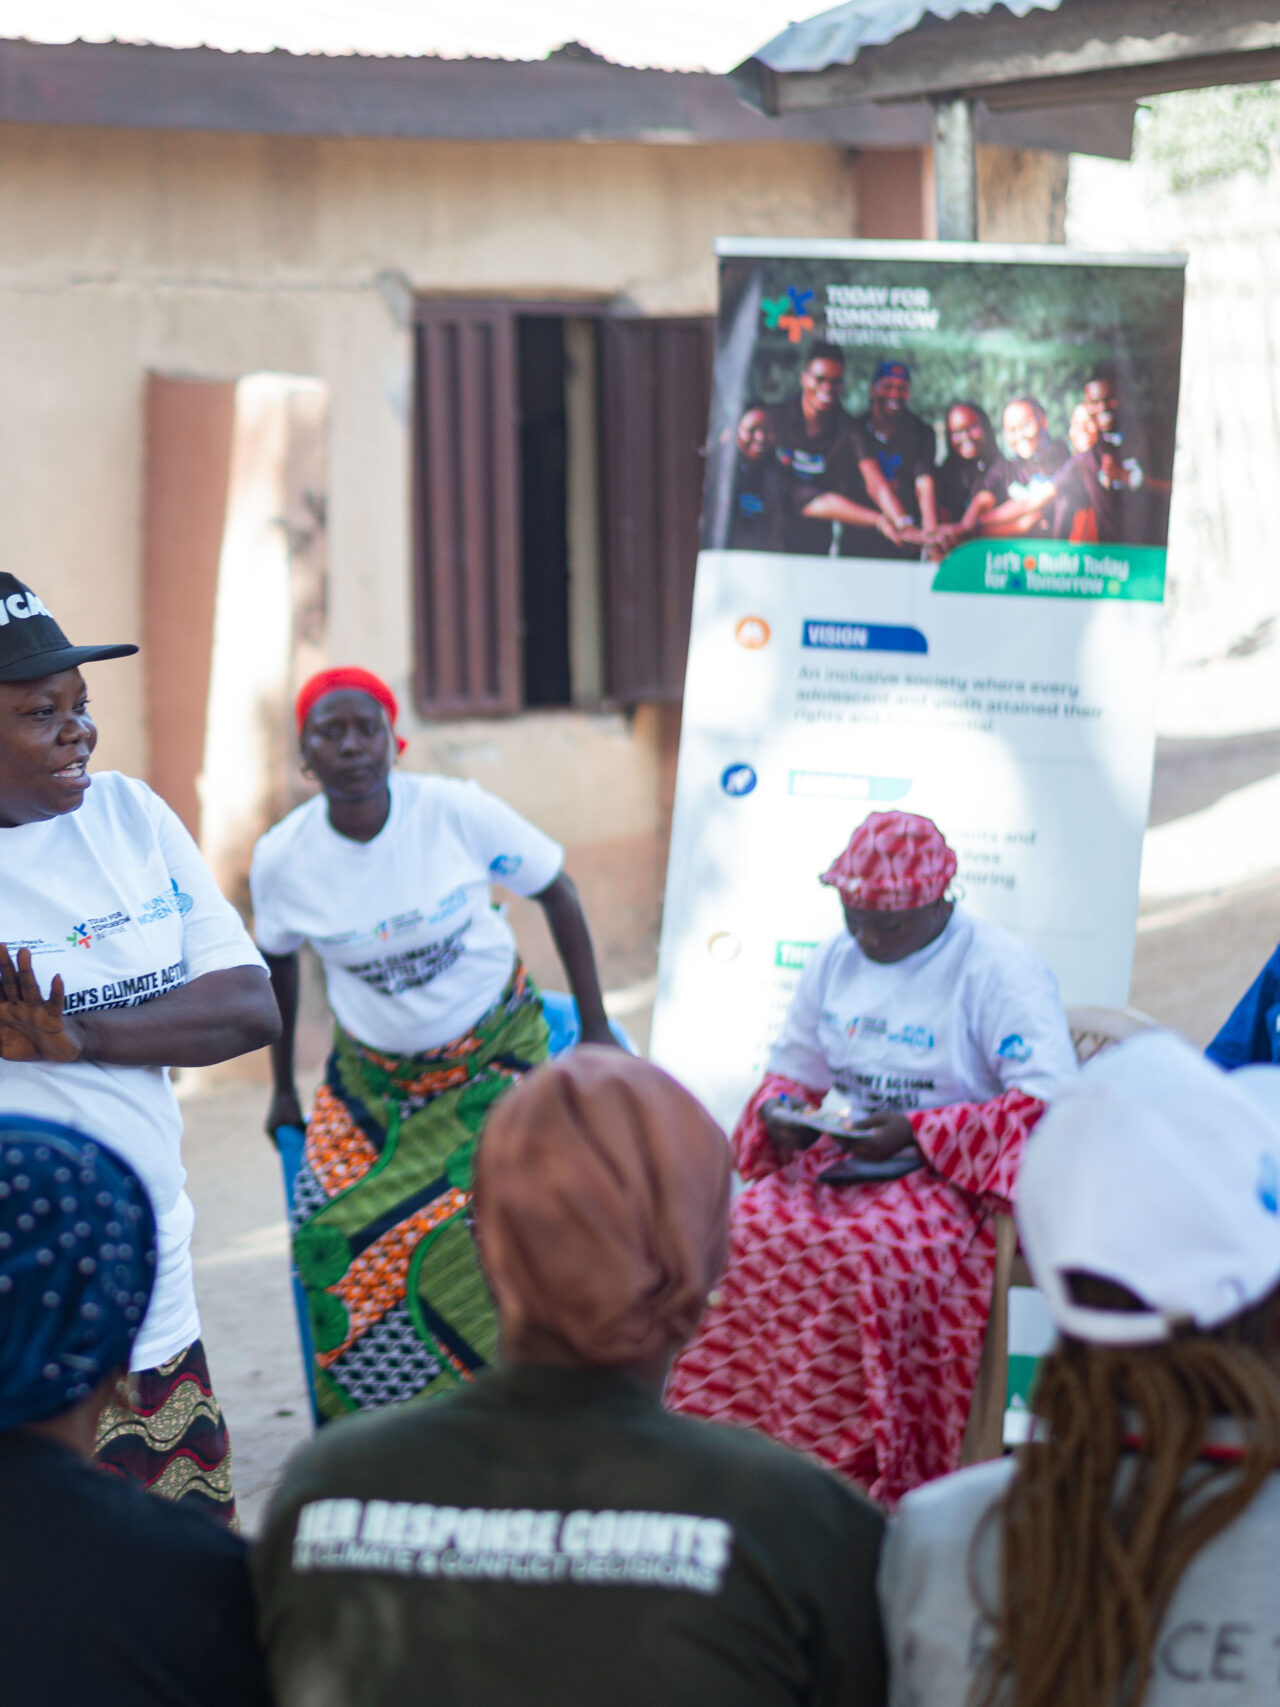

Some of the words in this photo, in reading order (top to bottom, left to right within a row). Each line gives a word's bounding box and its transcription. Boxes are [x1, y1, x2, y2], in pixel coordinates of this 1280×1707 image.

[825, 285, 888, 306] TODAY
[889, 287, 931, 308] FOR
[824, 306, 939, 330] TOMORROW
[985, 550, 1020, 573] Let's
[1038, 552, 1080, 575] Build
[1083, 554, 1130, 582] Today
[1025, 570, 1104, 595] Tomorrow
[808, 623, 868, 647] VISION
[798, 664, 820, 680] An
[825, 666, 900, 685] inclusive
[904, 671, 967, 692] society
[972, 675, 1026, 693] where
[1030, 681, 1080, 699] every
[1063, 703, 1103, 719] their
[63, 987, 99, 1012] EN'S
[102, 971, 159, 1002] CLIMATE
[361, 1499, 563, 1556] RESPONSE
[560, 1509, 733, 1571] COUNTS
[440, 1549, 568, 1583] CONFLICT
[570, 1552, 721, 1594] DECISIONS
